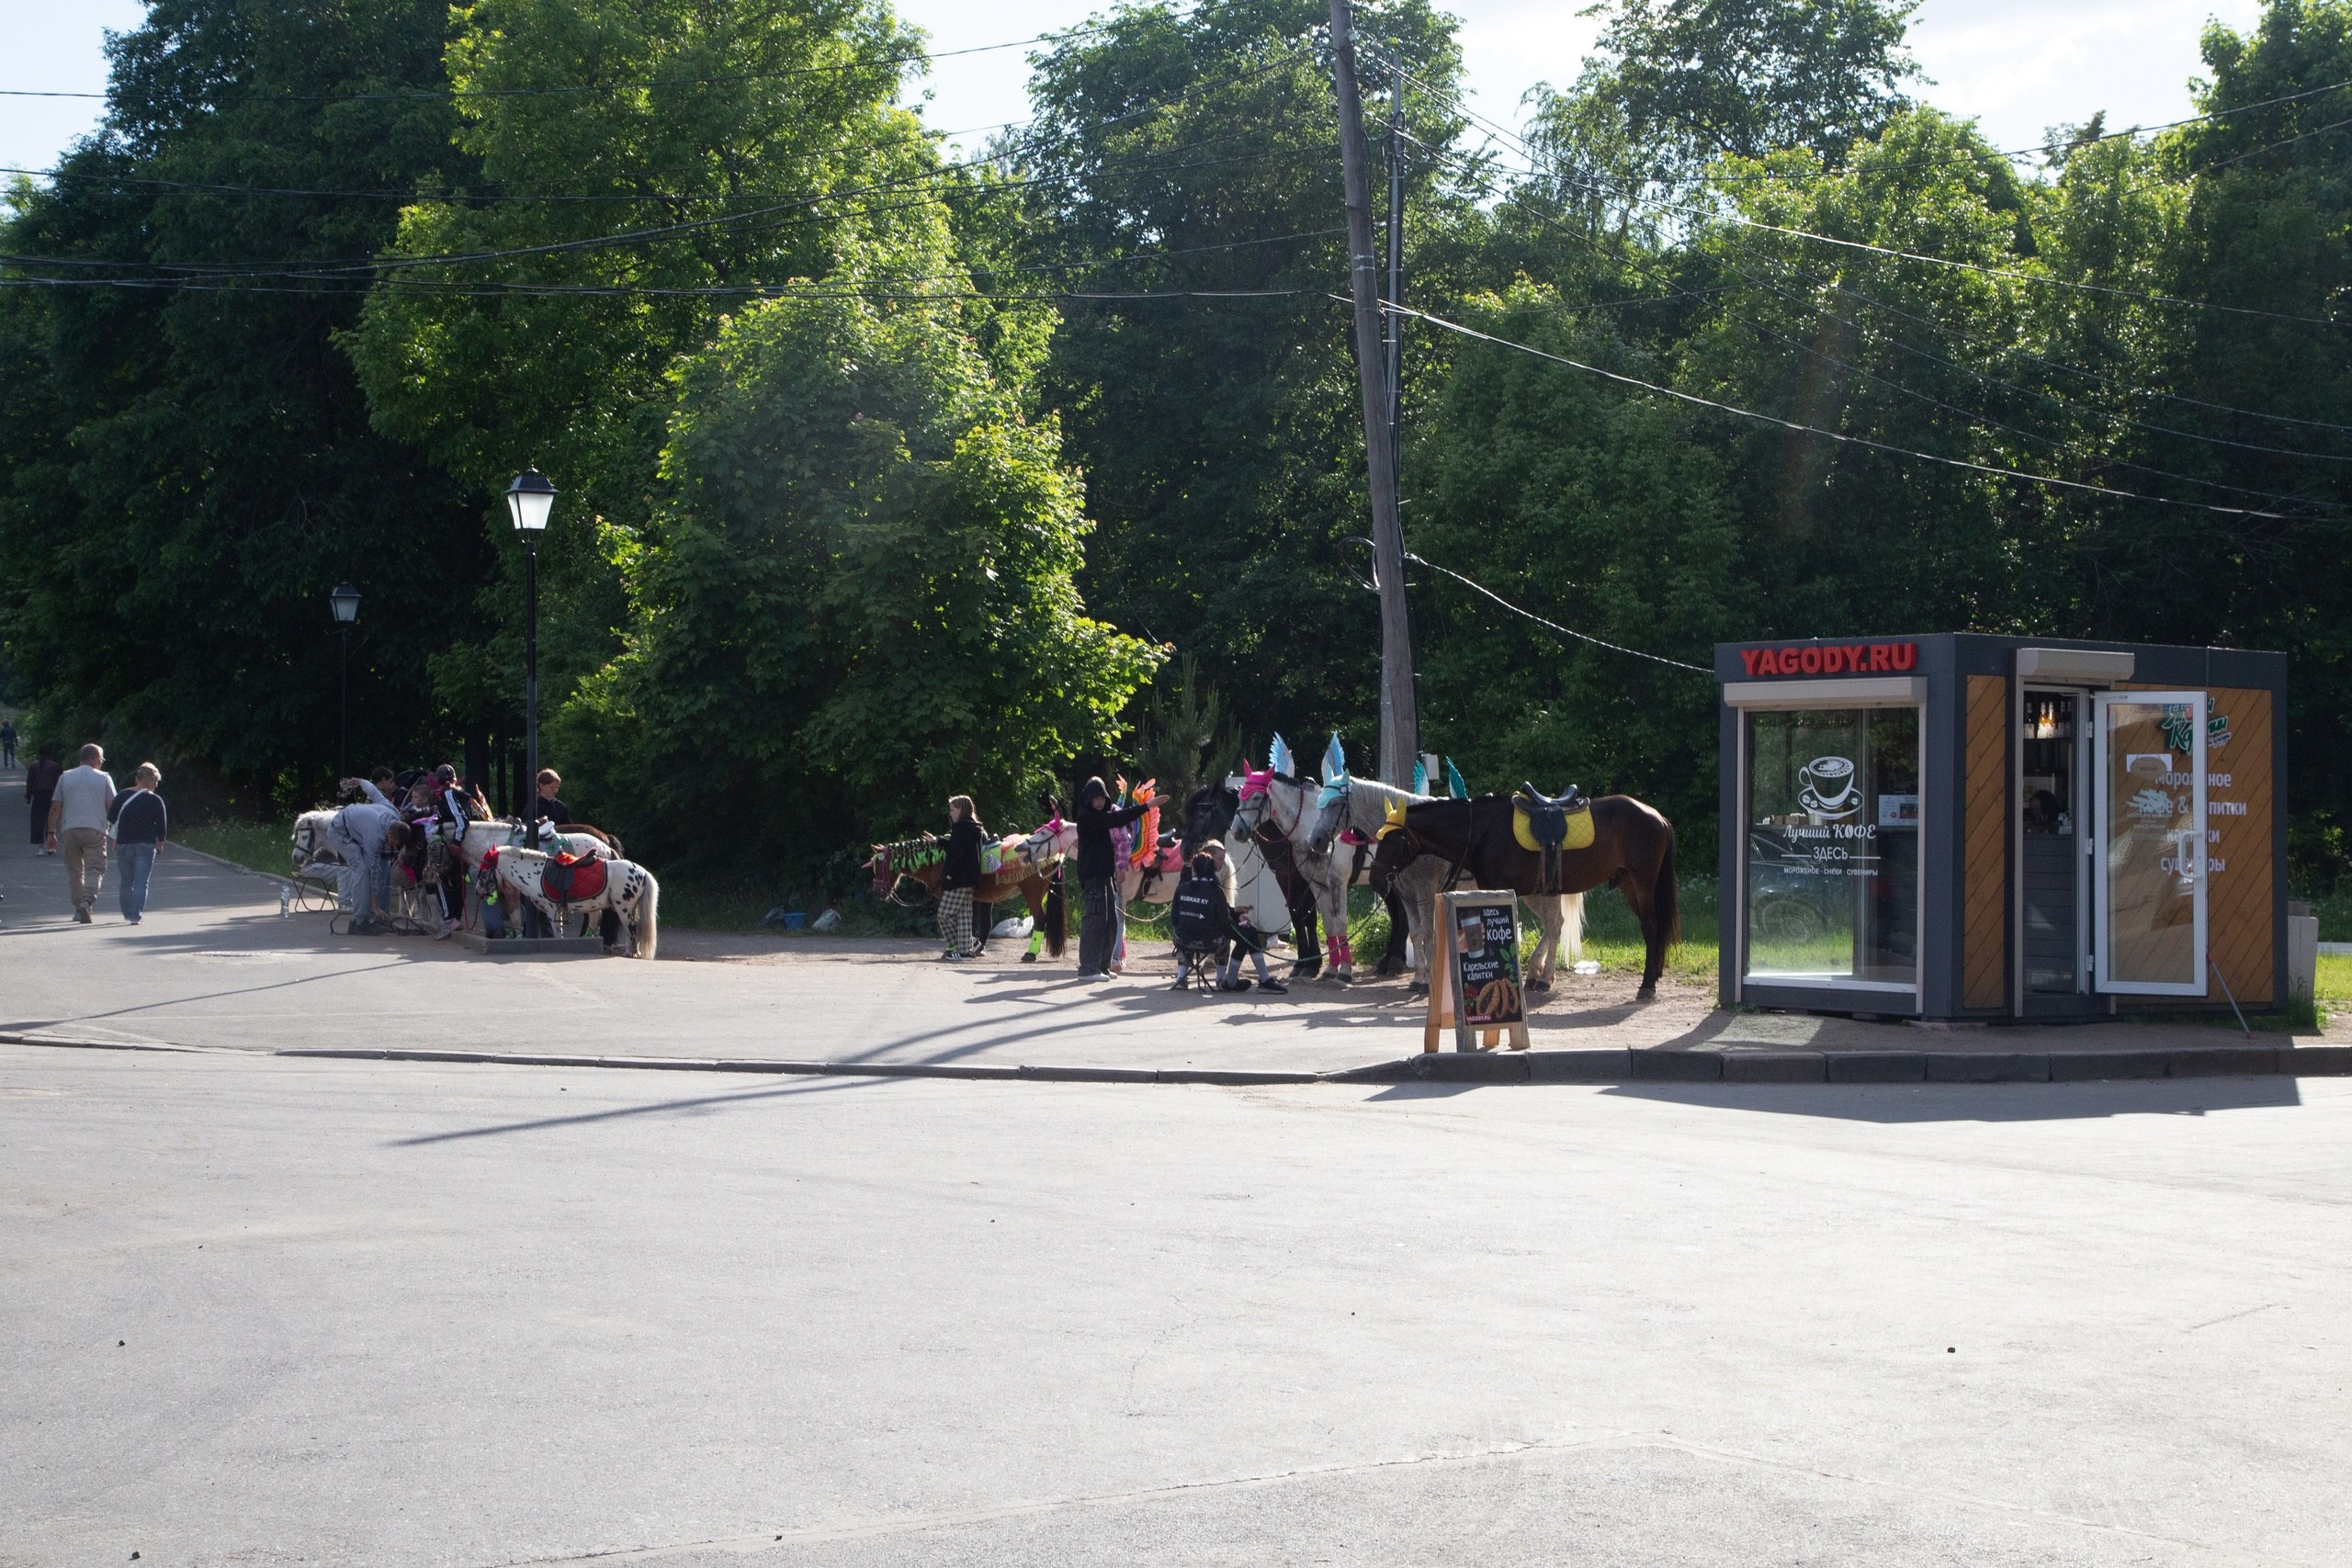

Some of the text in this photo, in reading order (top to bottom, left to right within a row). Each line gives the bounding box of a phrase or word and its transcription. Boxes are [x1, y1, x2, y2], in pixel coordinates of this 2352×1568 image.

[1740, 643, 1916, 675] YAGODY.RU
[2177, 795, 2188, 814] &
[2208, 801, 2247, 816] питки
[1782, 823, 1877, 843] Лучший КОФЕ
[1813, 846, 1849, 862] ЗДЕСЬ
[1783, 866, 1820, 875] МОРОЖЕНОЕ
[1846, 868, 1879, 876] СУВЕНИРЫ
[1483, 908, 1499, 917] здесь
[1487, 915, 1510, 928] лучший
[1487, 926, 1512, 945] кофе
[1463, 960, 1499, 975] Карельские
[1466, 971, 1494, 981] калитки
